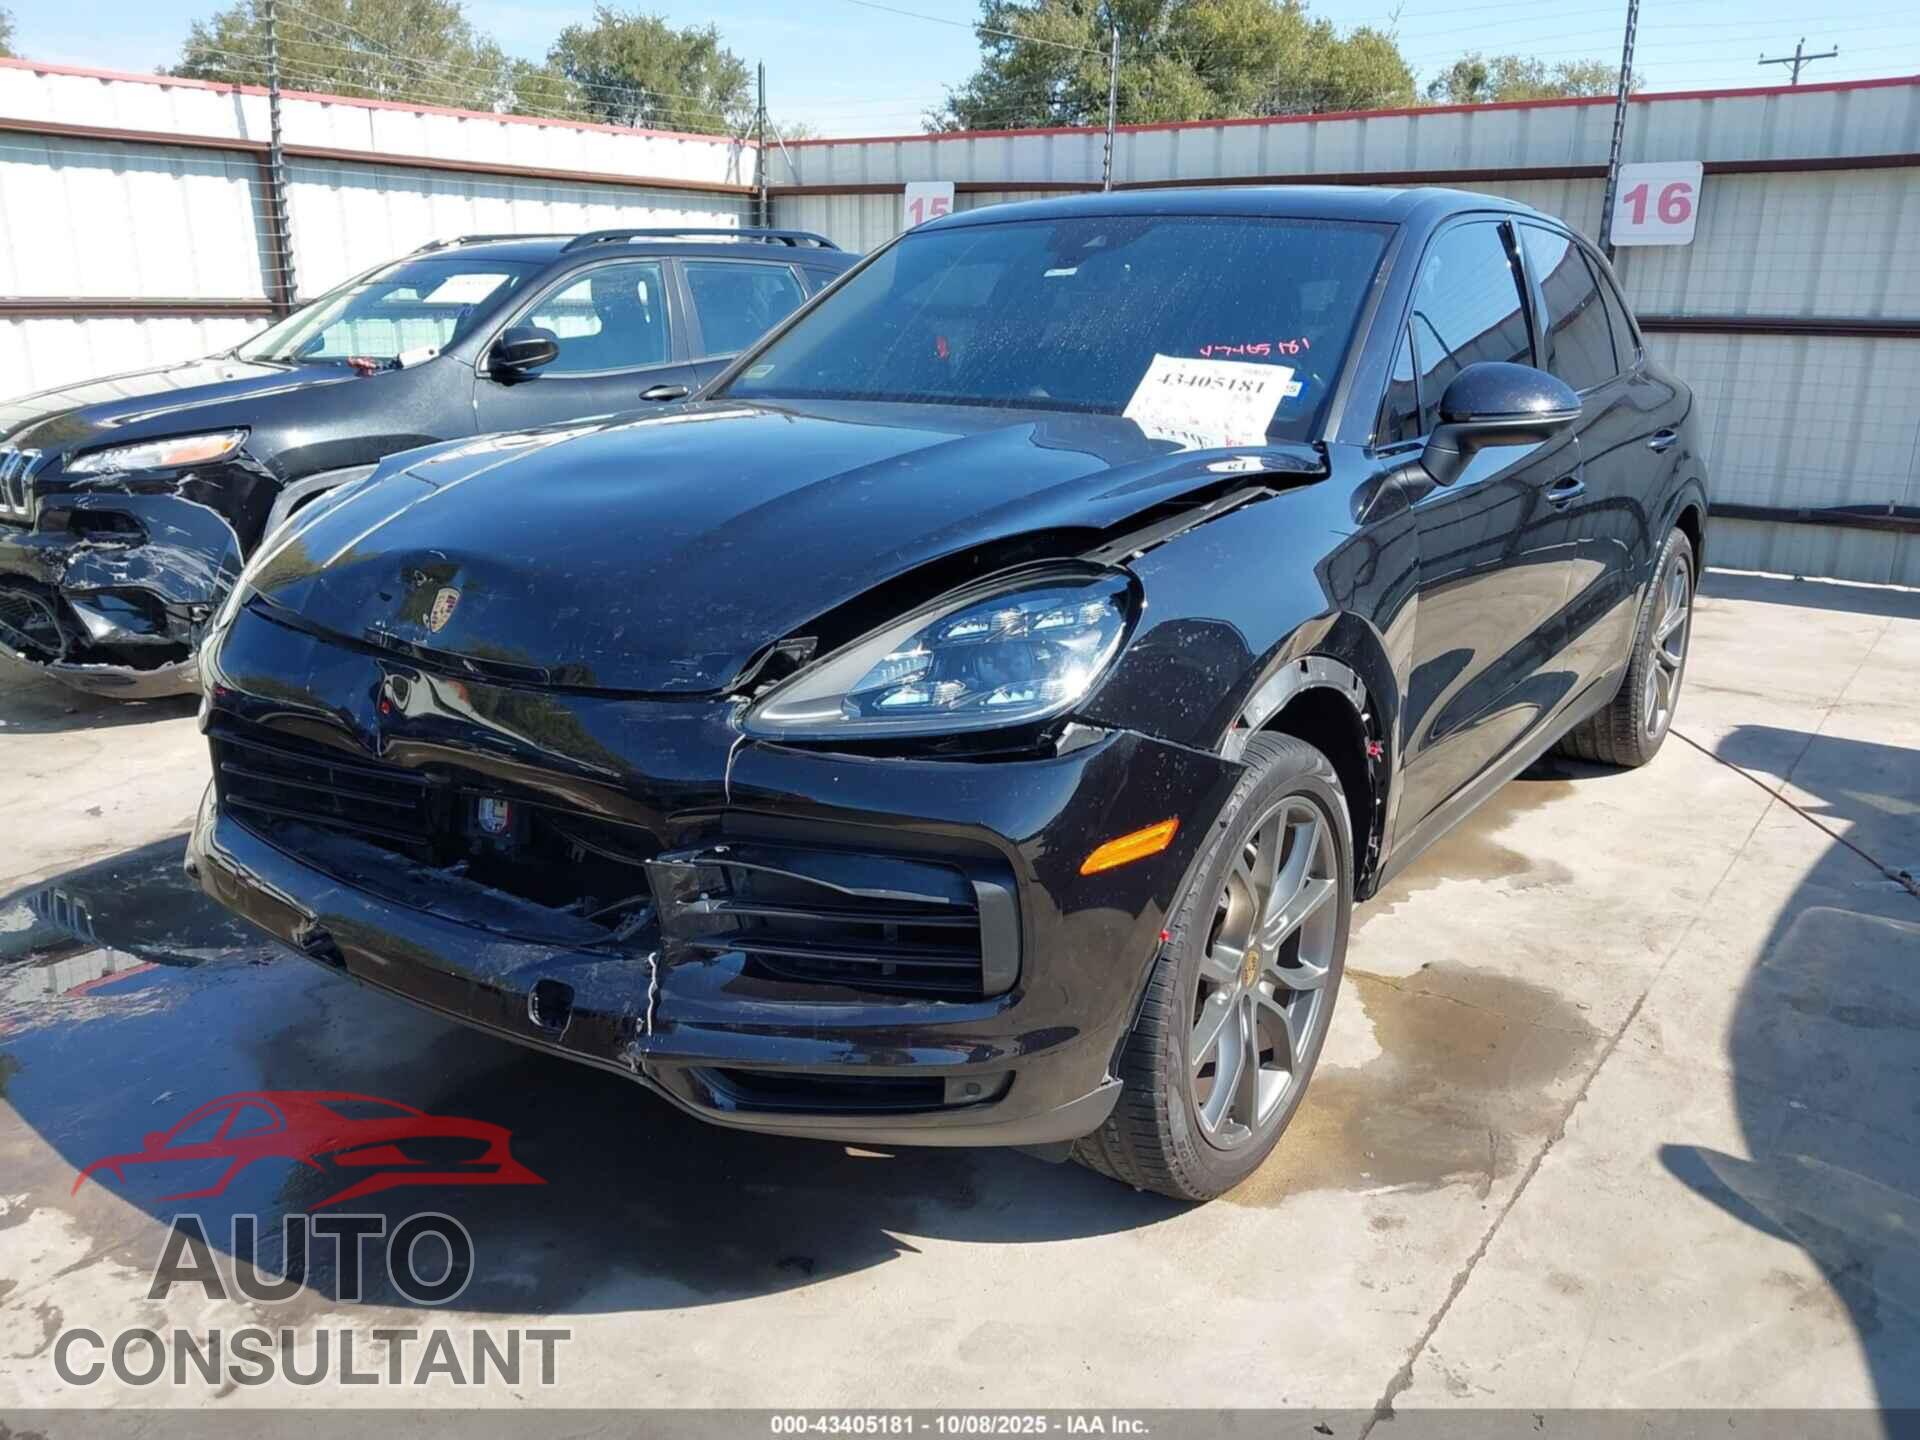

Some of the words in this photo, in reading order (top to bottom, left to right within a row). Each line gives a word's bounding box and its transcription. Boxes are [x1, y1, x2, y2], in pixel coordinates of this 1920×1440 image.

[910, 197, 950, 225] 15
[1623, 182, 1693, 225] 16
[1156, 372, 1265, 394] 43405181
